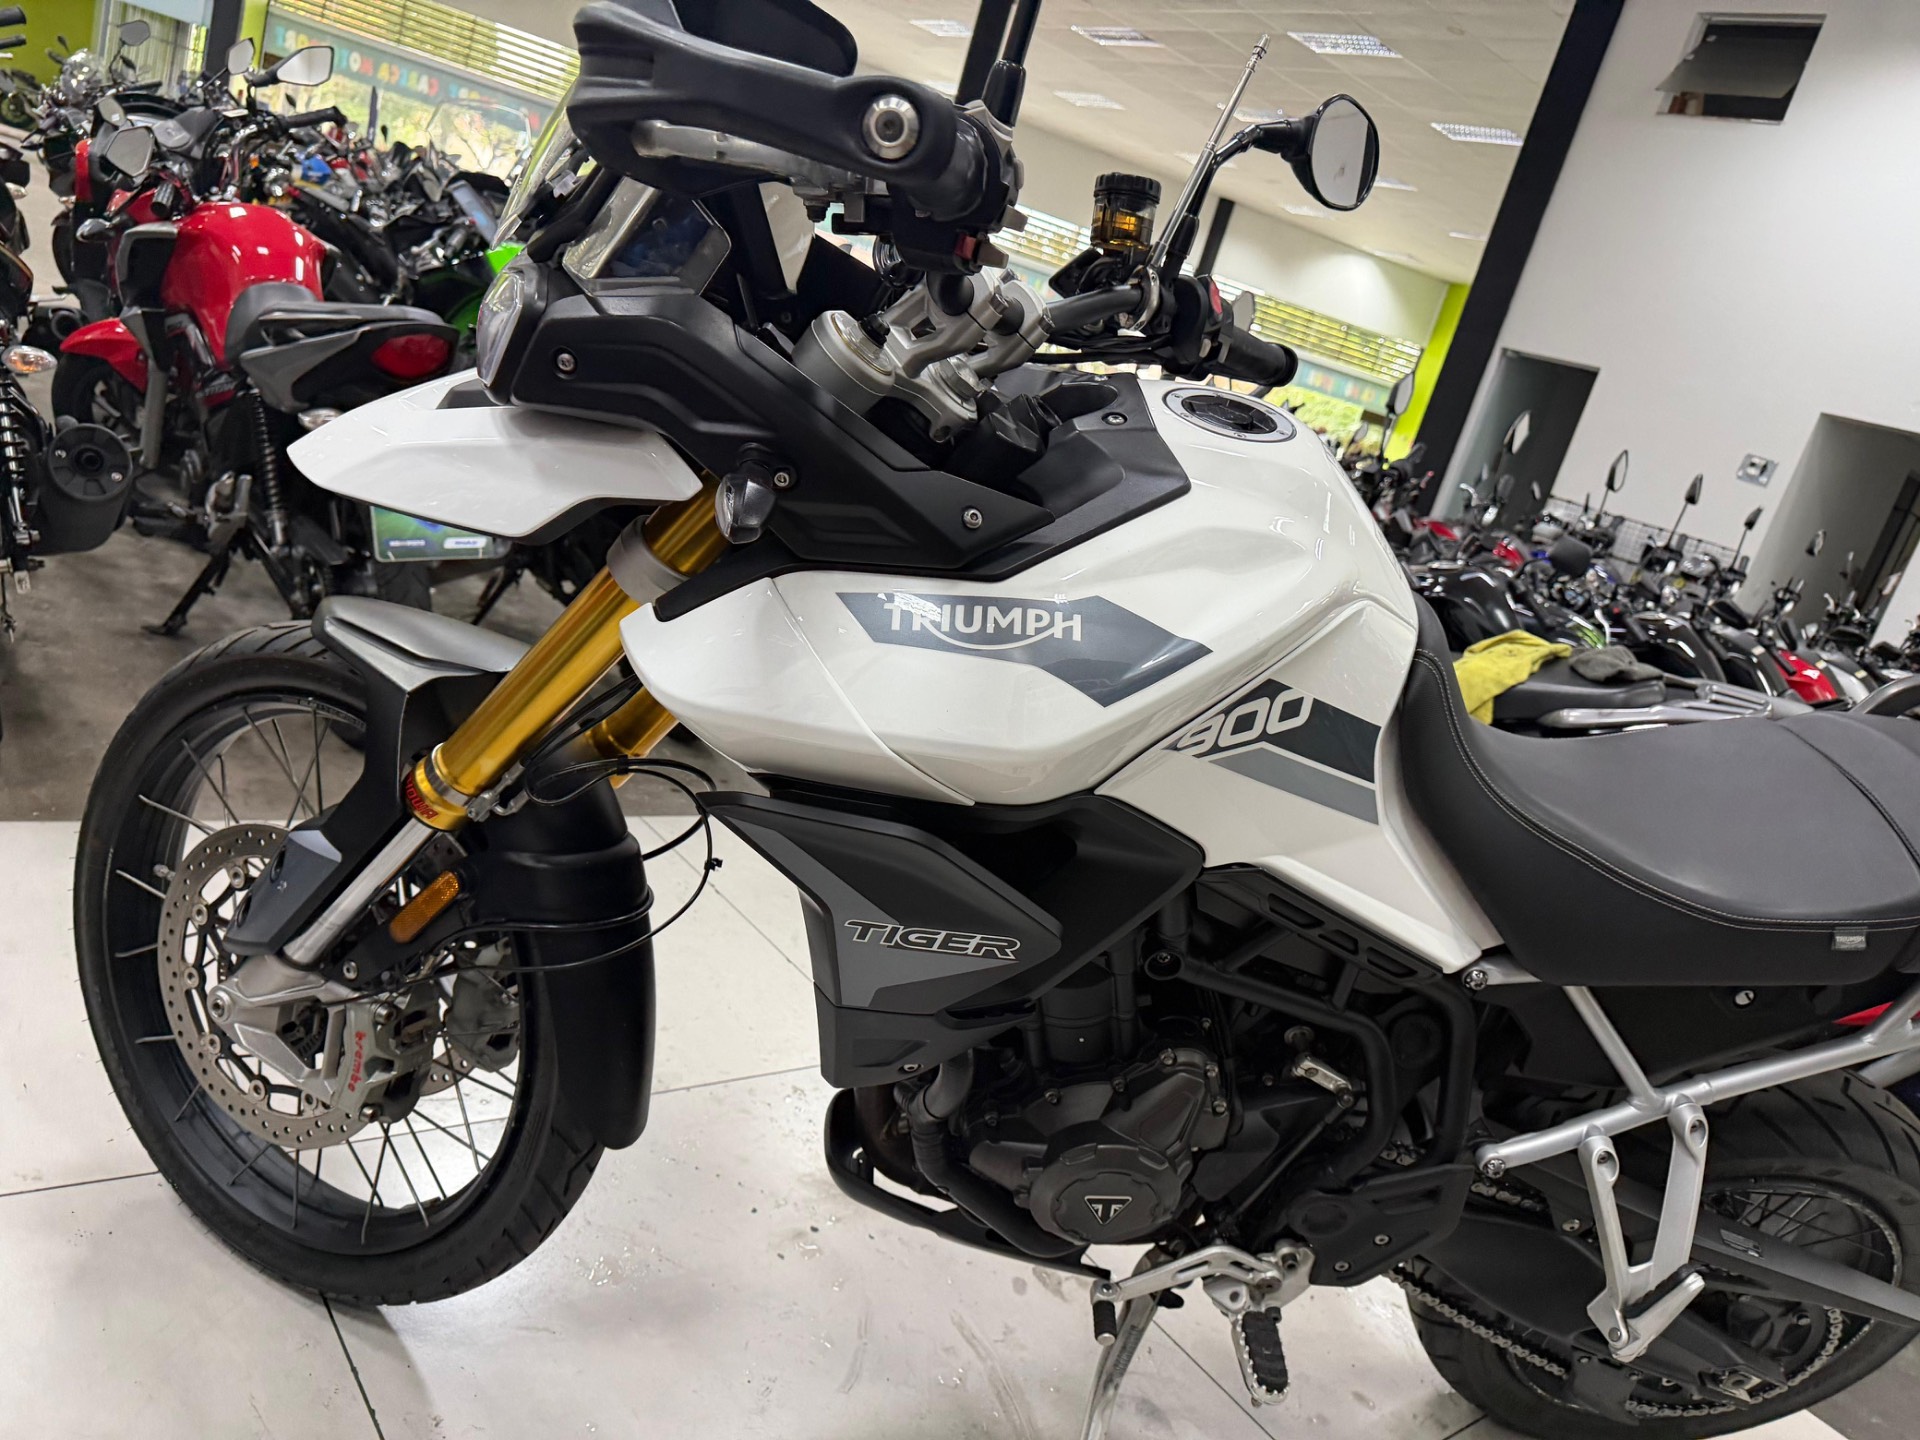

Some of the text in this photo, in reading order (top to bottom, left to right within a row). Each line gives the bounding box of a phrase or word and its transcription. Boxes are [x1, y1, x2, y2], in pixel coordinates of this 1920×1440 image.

[883, 602, 1082, 650] TRIUMPH
[1176, 688, 1315, 757] 900
[844, 919, 1021, 960] TIGER
[347, 1031, 367, 1093] brembo
